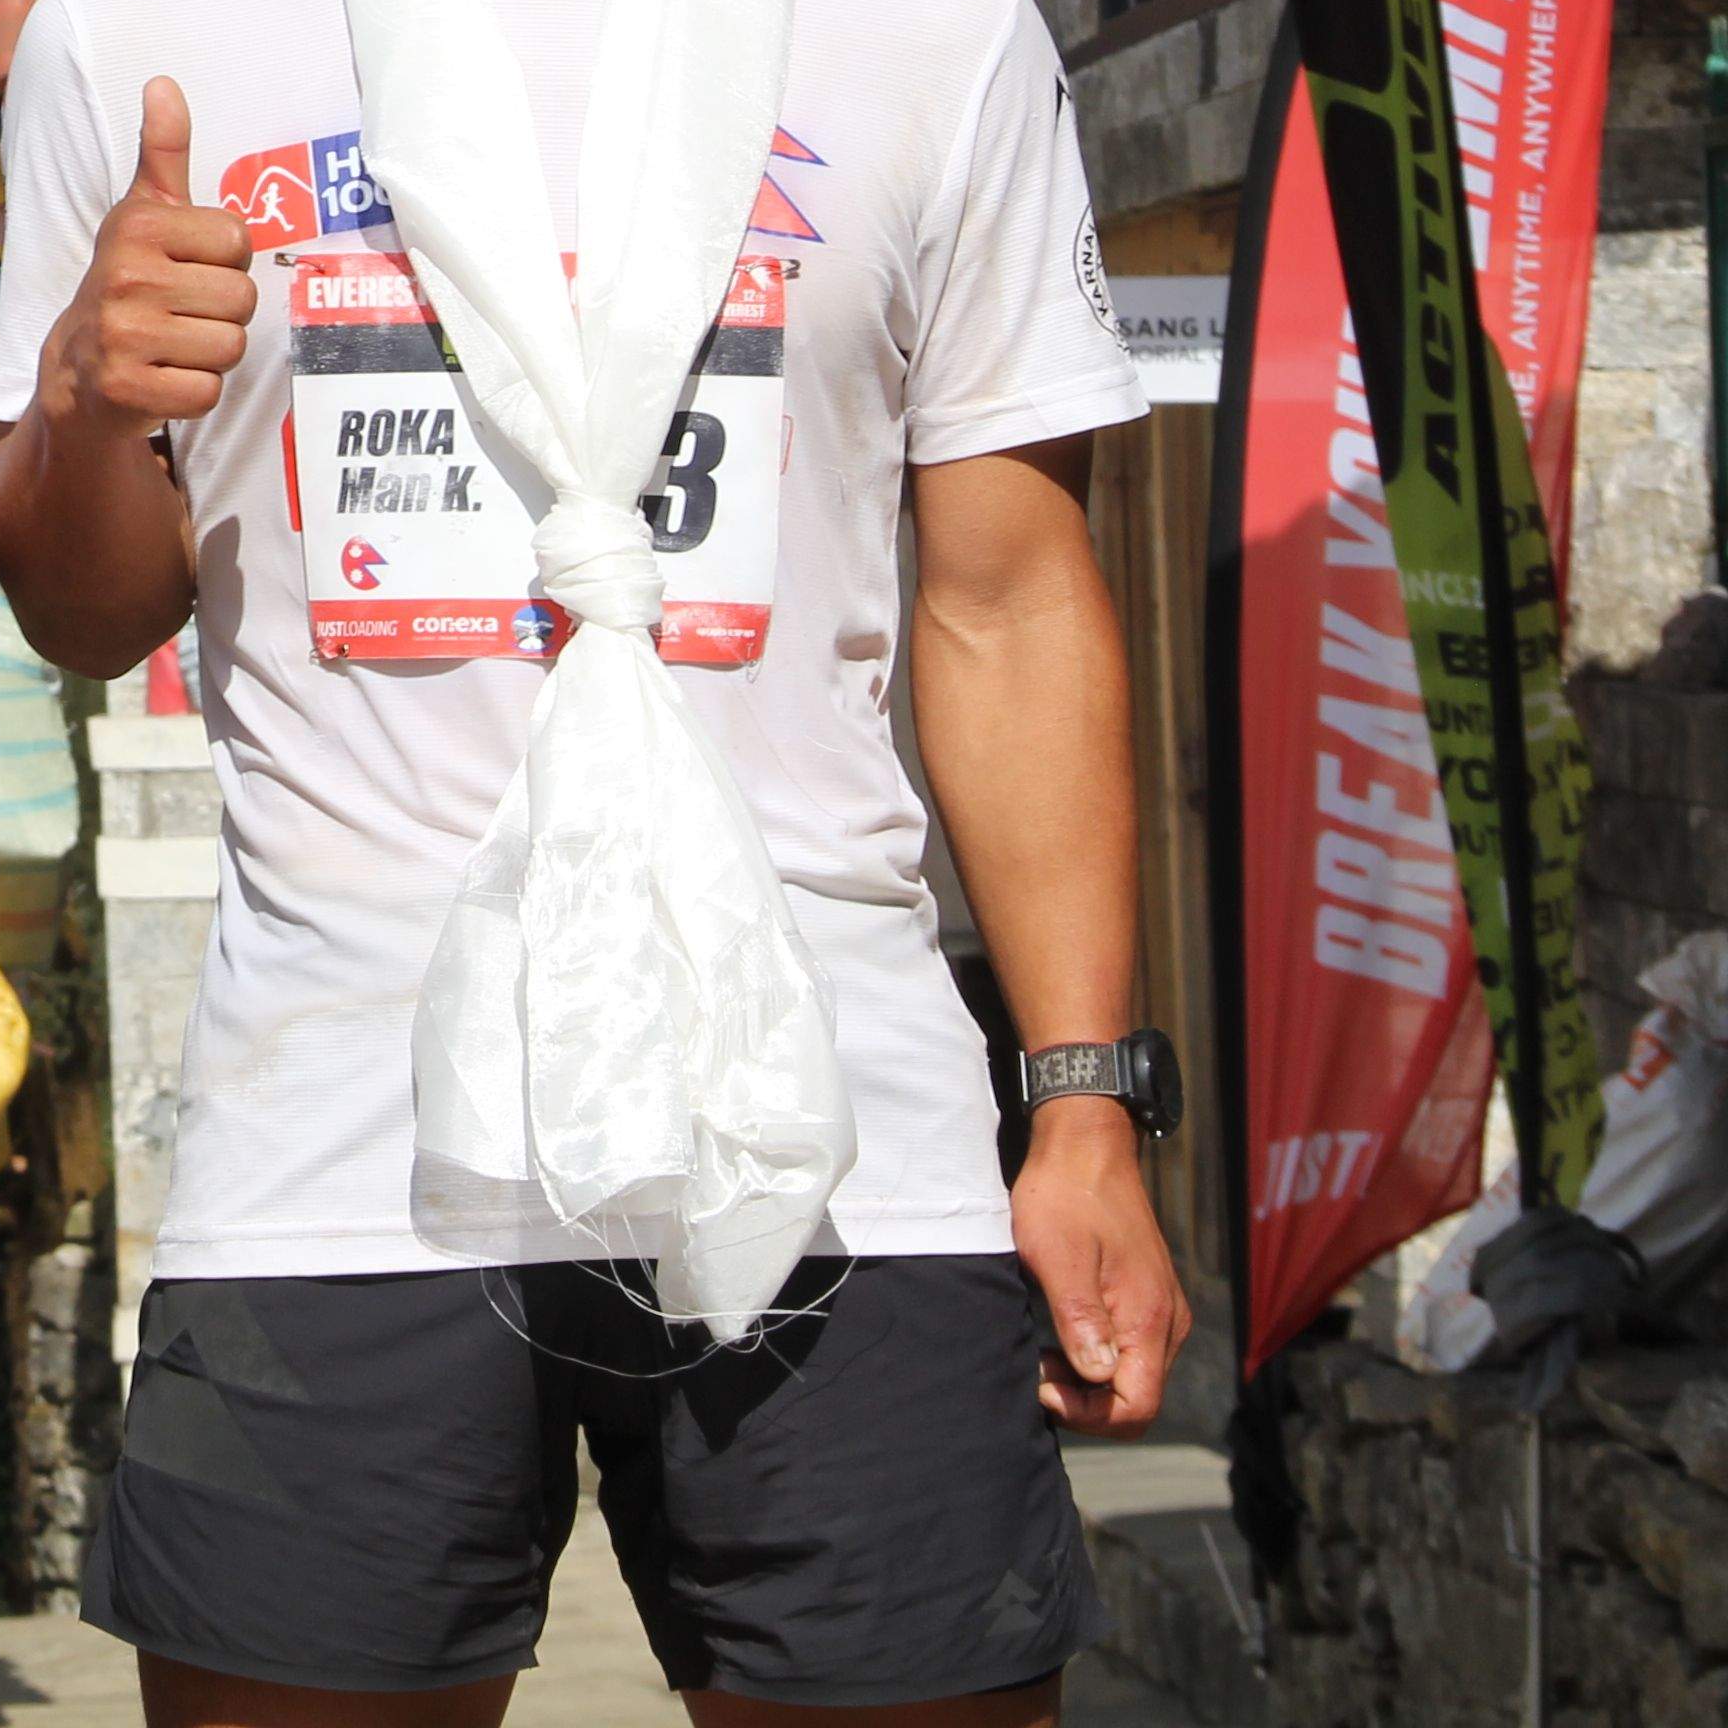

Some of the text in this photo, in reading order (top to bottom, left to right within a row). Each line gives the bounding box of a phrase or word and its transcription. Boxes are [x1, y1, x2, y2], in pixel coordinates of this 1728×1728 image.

[1508, 182, 1546, 351] ANYTIME,
[336, 409, 455, 456] ROKA
[336, 465, 482, 515] Man K.
[637, 410, 727, 554] 3
[1324, 307, 1399, 570] YO
[411, 614, 499, 634] conexa
[1315, 602, 1450, 1000] BREAK
